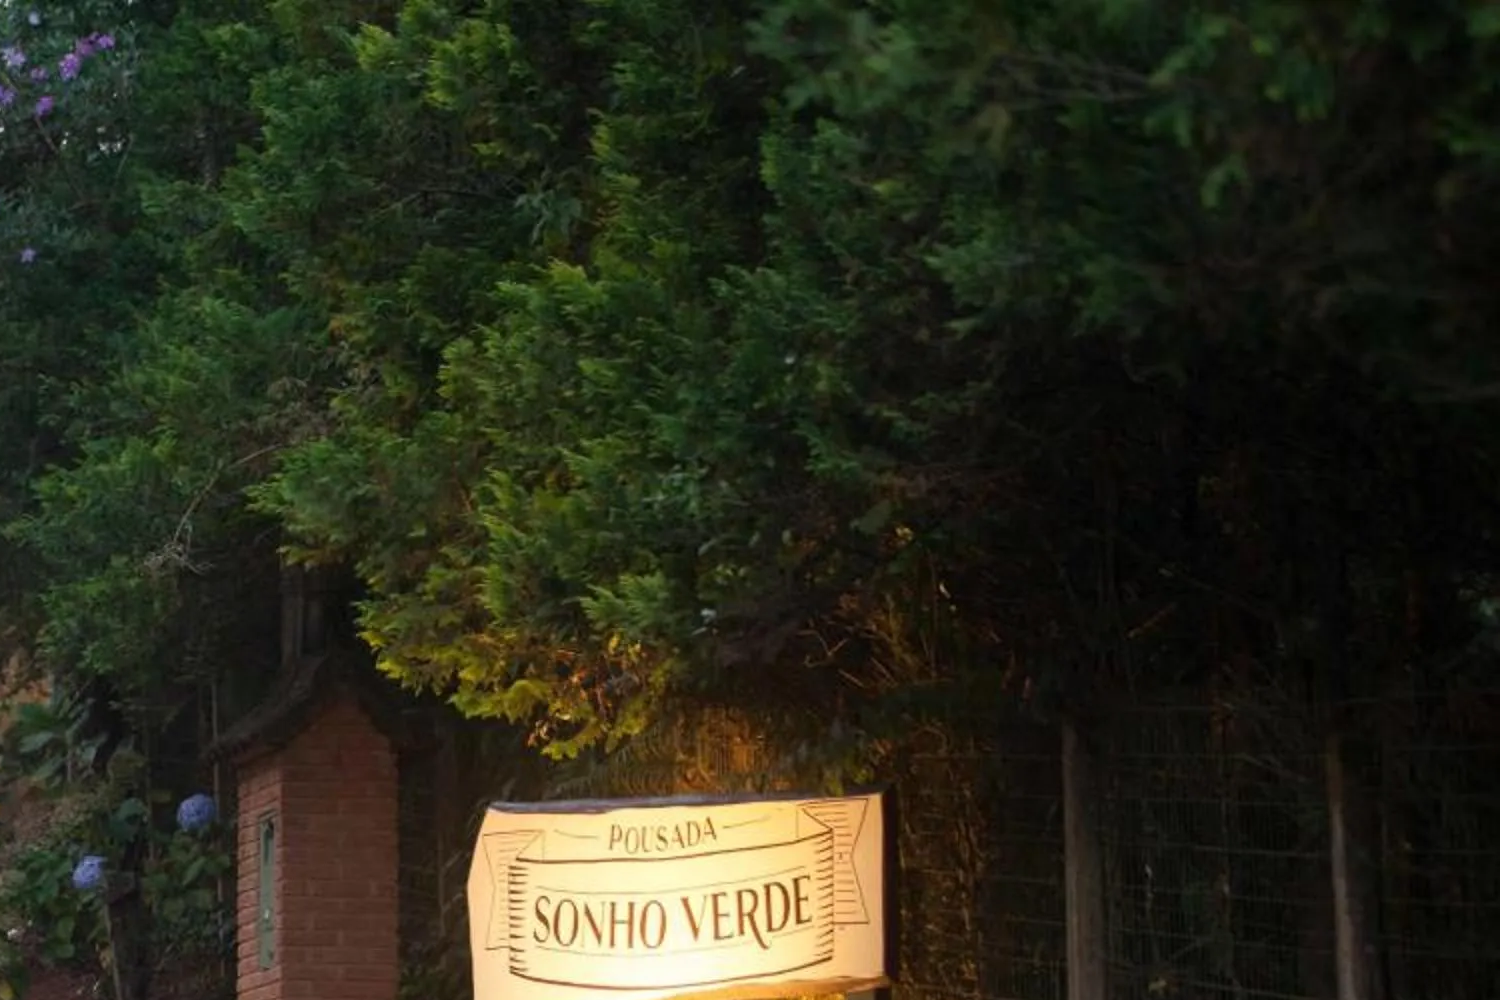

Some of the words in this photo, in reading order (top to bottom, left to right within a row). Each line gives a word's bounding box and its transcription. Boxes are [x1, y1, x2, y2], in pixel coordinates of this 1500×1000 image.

[608, 816, 717, 853] POUSADA
[533, 895, 668, 949] SONHO
[680, 875, 812, 949] VERDE
